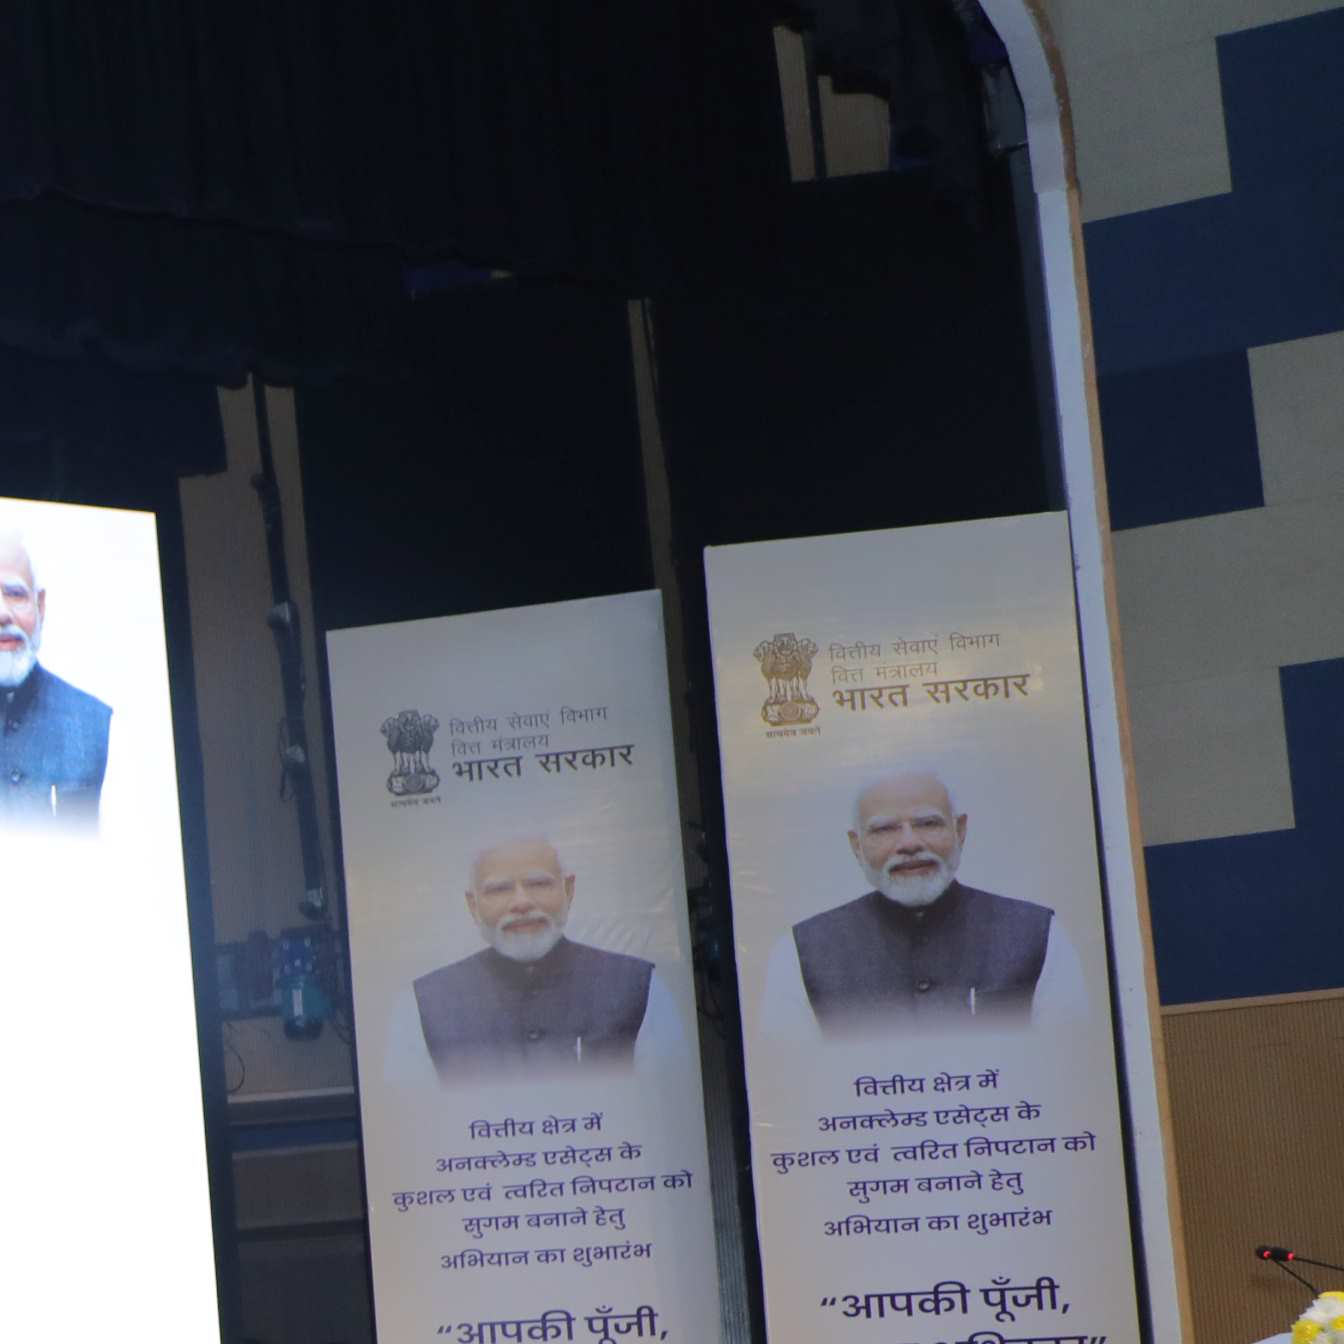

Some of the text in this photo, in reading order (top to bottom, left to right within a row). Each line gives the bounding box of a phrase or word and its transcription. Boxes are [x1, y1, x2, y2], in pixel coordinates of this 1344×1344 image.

[832, 674, 1030, 711] भारत सरकार
[453, 744, 634, 783] भारत सरकार
[854, 1069, 1000, 1097] वित्तीय क्षेत्र में
[469, 1112, 604, 1140] वित्तीय क्षेत्र में
[818, 1101, 1042, 1133] अनक्लेम्ड एसेट्स के
[436, 1142, 642, 1174] अनक्लेम्ड एसेट्स के
[771, 1132, 1097, 1175] कुशल एवं त्वरित निपटान को
[847, 1169, 1024, 1204] सुगम बनाने हेतु
[824, 1207, 1052, 1237] अभियान का शुभारंभ
[820, 1276, 1070, 1323] “आपकी पूँजी,
[437, 1309, 576, 1344] “आपकी
